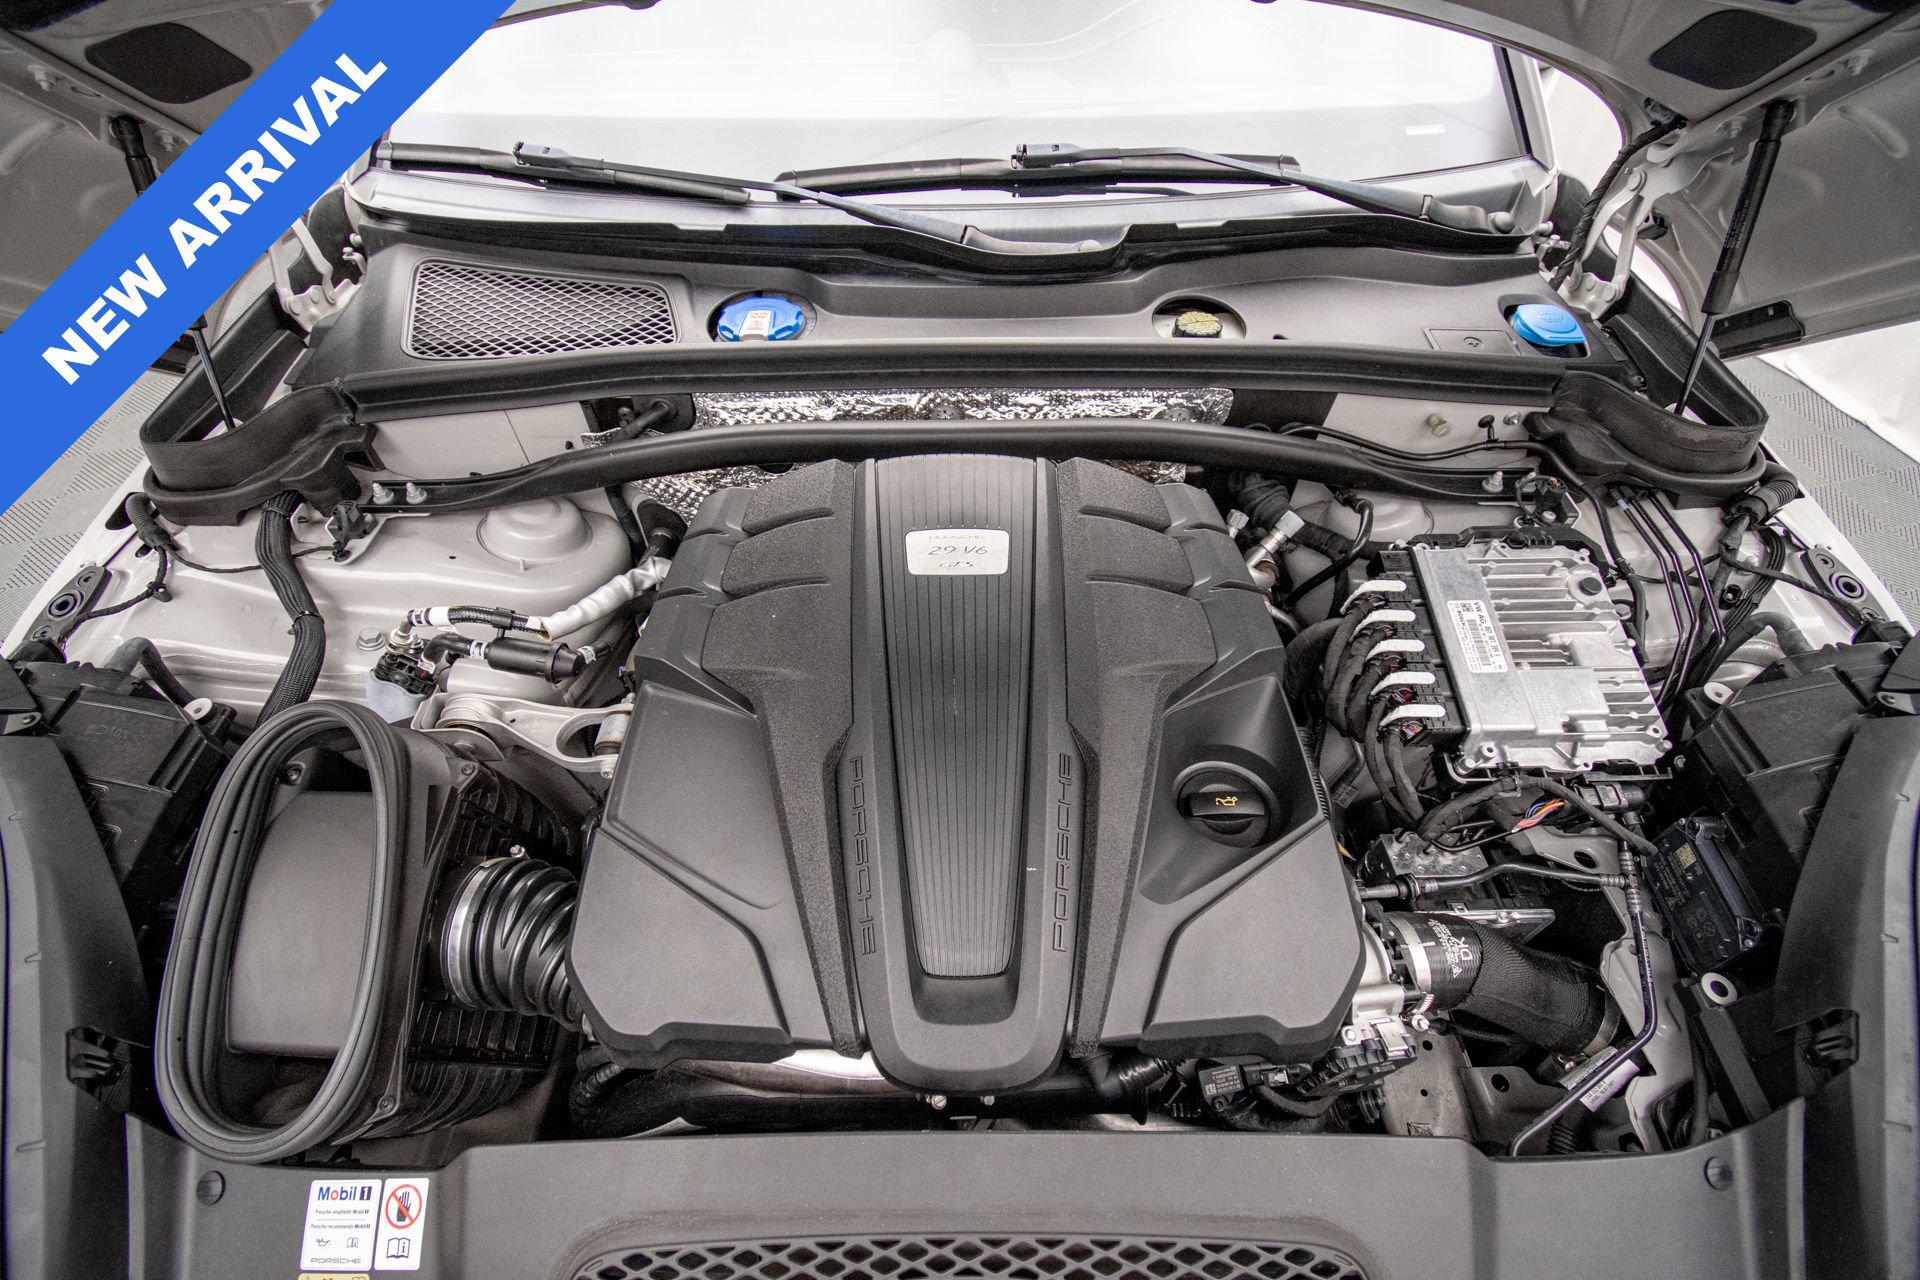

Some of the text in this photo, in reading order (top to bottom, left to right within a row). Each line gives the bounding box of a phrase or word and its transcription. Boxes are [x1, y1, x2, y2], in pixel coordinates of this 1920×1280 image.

[964, 545, 988, 555] V6
[1474, 602, 1483, 613] VW
[1457, 611, 1466, 628] BOSCH
[1477, 614, 1487, 625] AG
[849, 755, 876, 956] PORSCHE
[1052, 752, 1074, 953] PORSCHE
[1457, 937, 1473, 961] DK
[317, 1186, 373, 1201] Mobil 1
